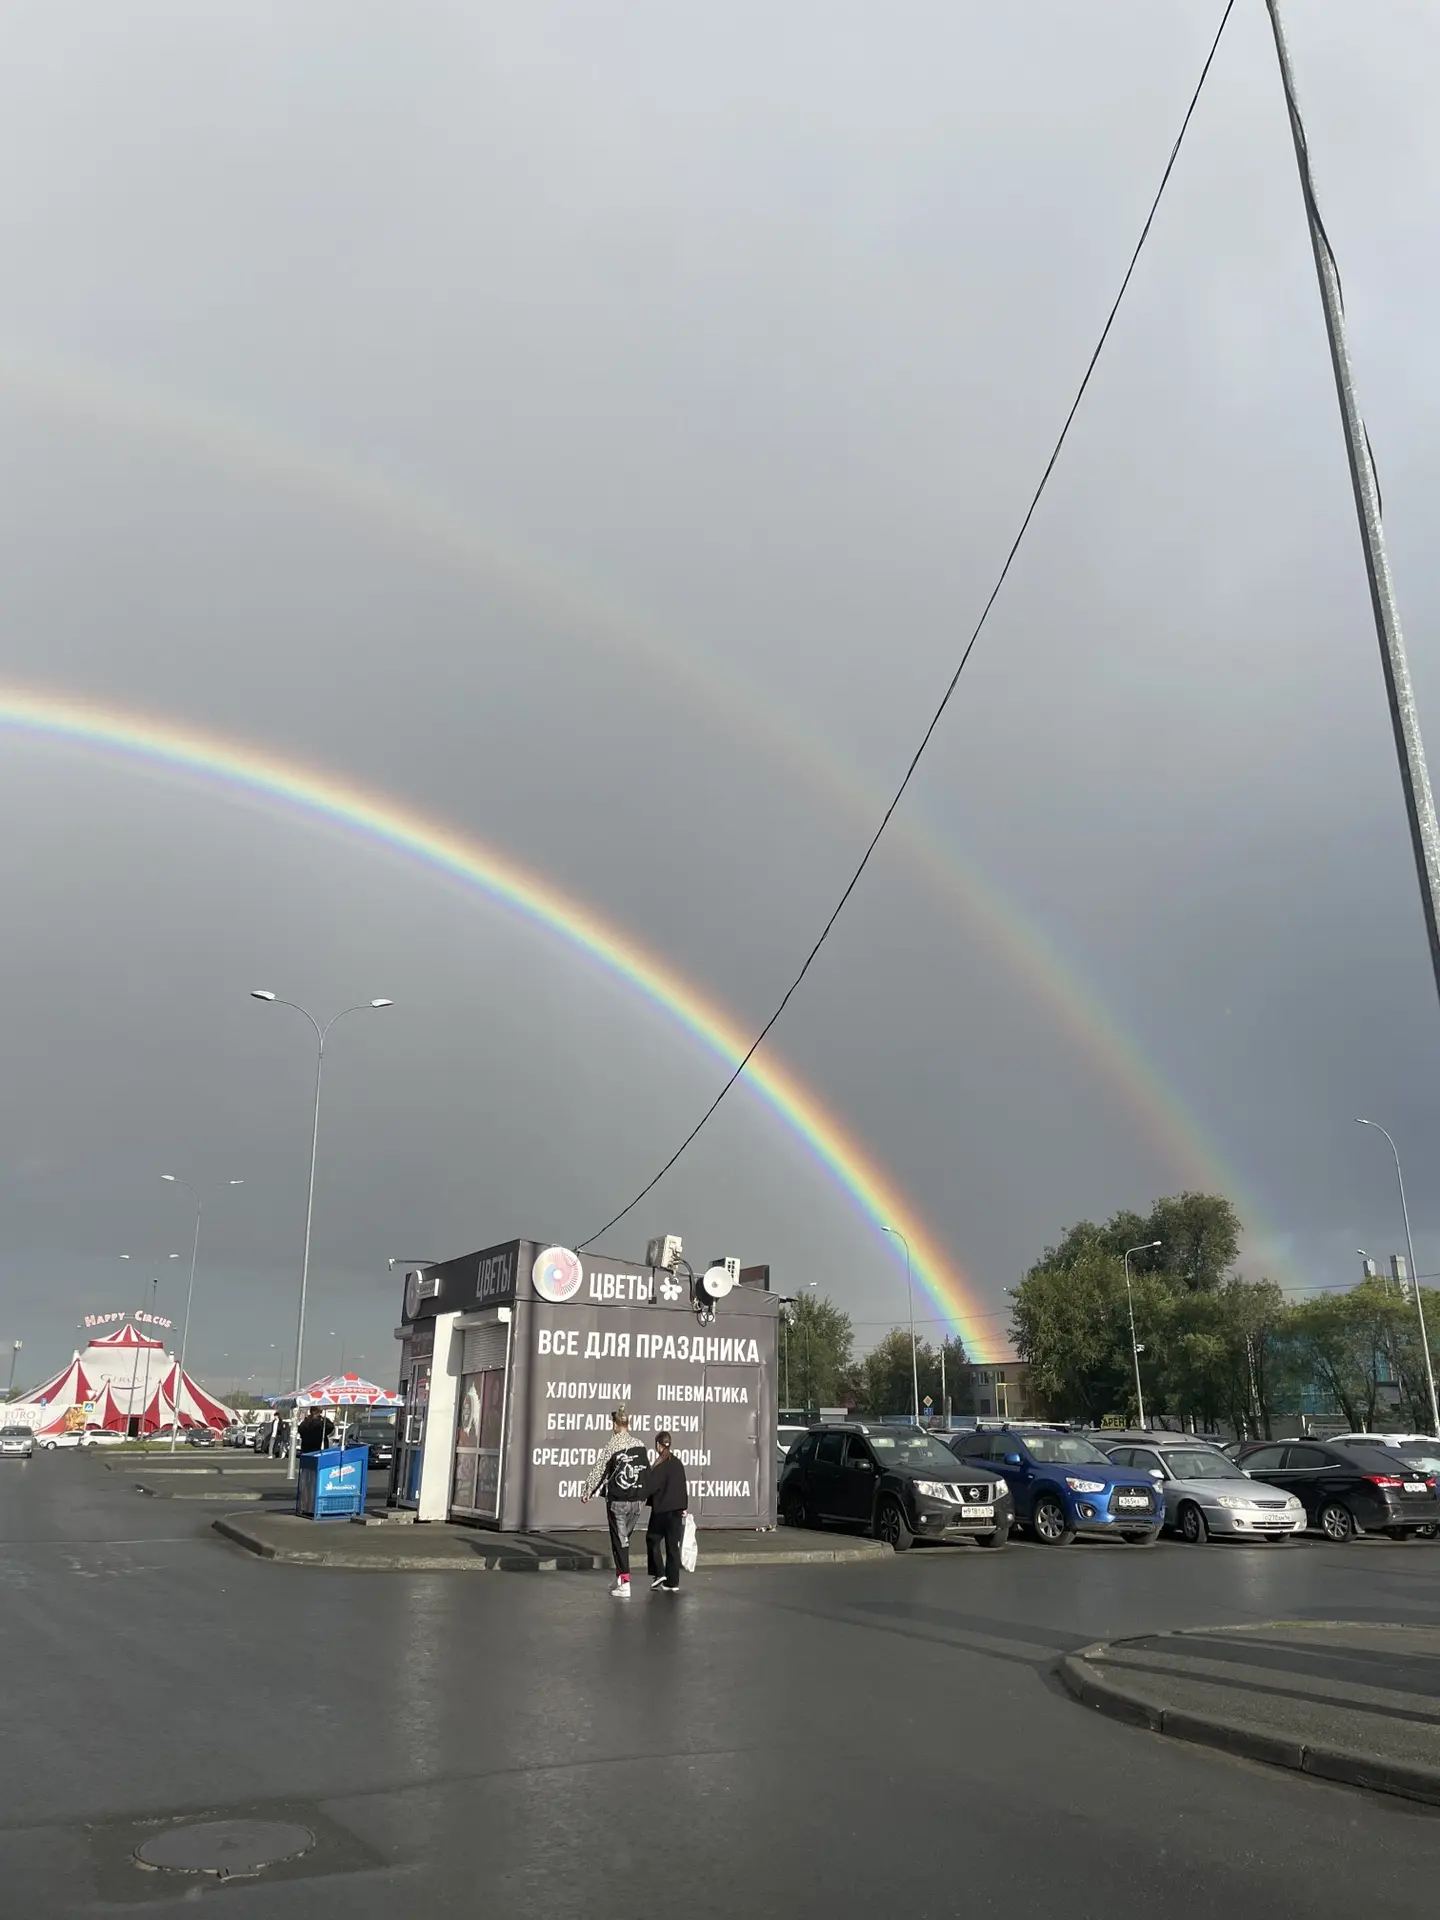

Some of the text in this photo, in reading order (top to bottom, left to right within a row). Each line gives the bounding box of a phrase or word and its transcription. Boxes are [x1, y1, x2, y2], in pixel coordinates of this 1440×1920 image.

[476, 1252, 513, 1302] ЦВЕТЫ
[589, 1273, 653, 1300] ЦВЕТЫ
[538, 1330, 760, 1363] ВСЕ ДЛЯ ПРАЗДНИКА
[546, 1382, 632, 1400] ХЛОПУШКИ
[657, 1385, 749, 1403] ПНЕВМАТИКА
[547, 1413, 699, 1432] БЕНГАЛЬКИЕ СВЕЧИ
[1102, 1417, 1138, 1428] АРЕНА
